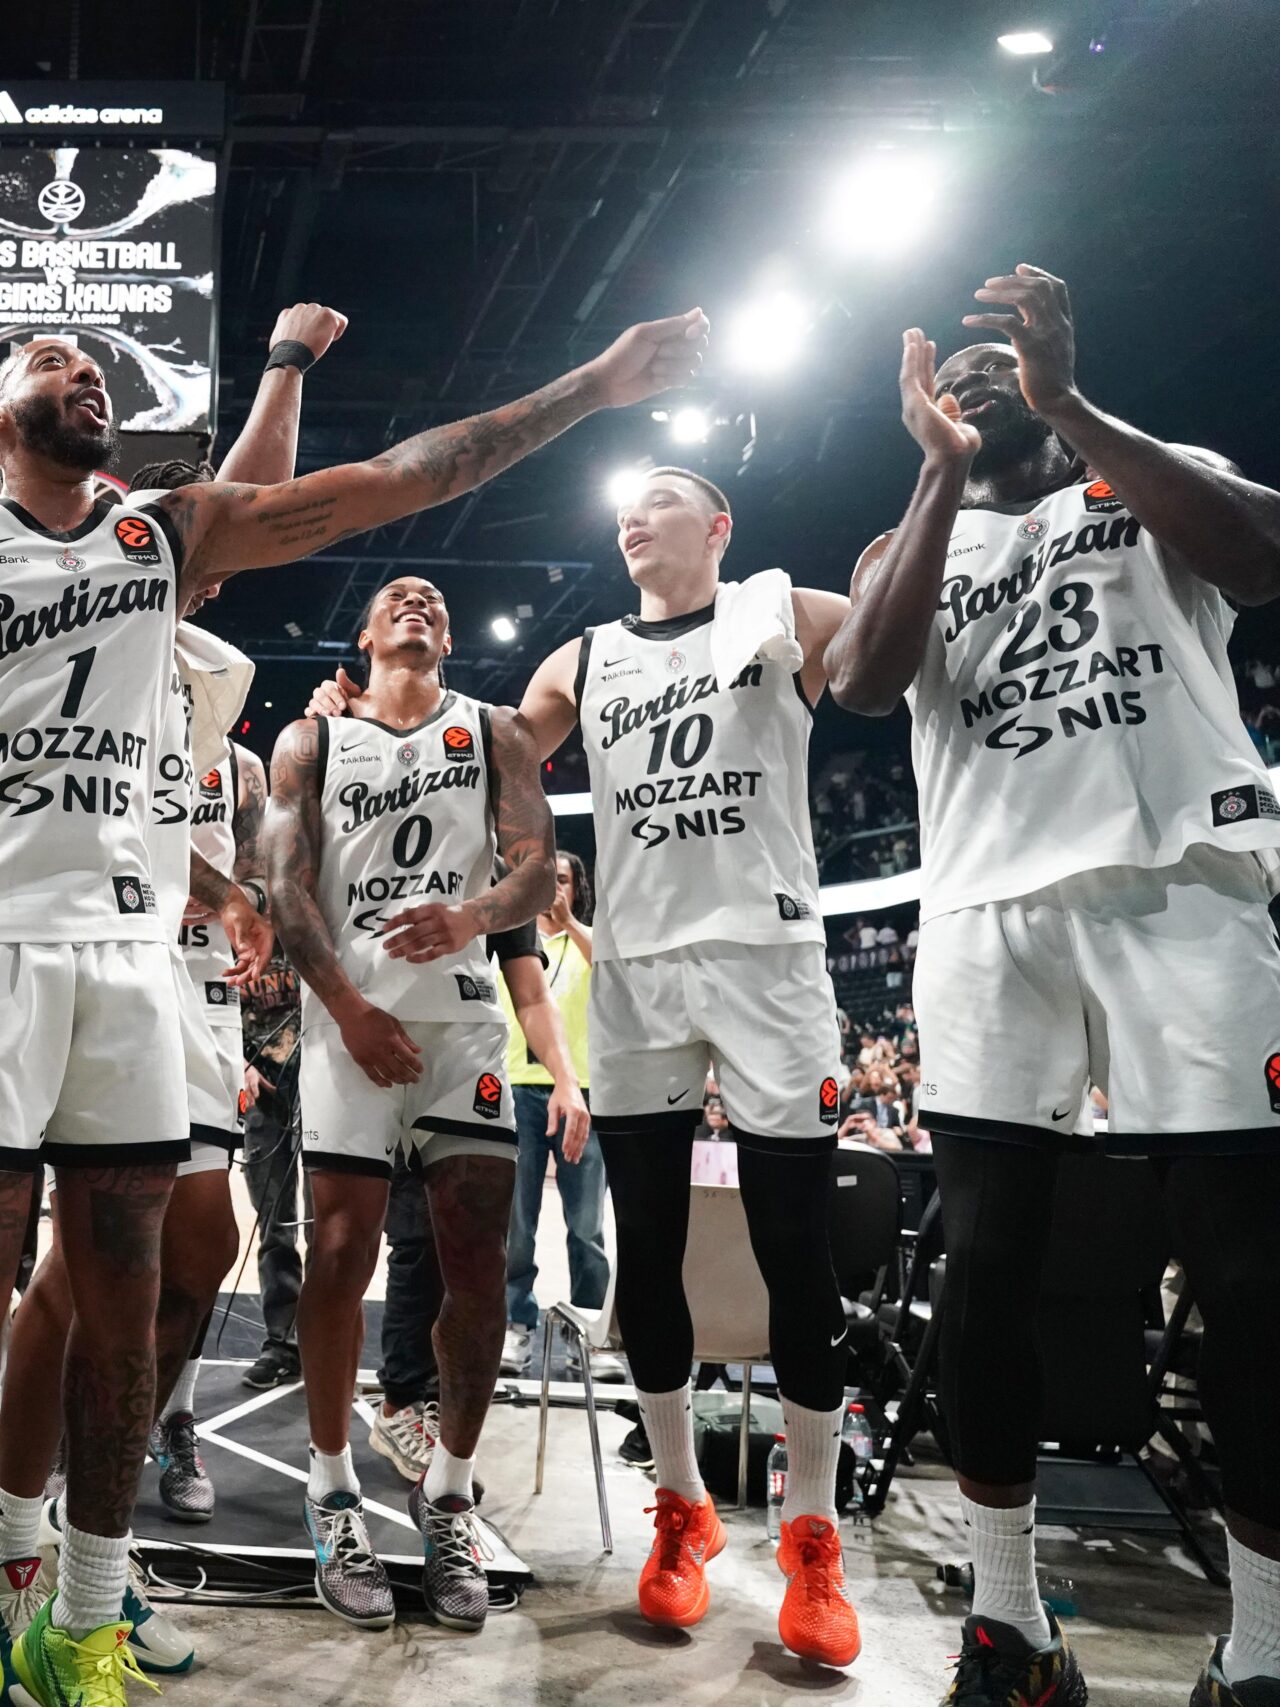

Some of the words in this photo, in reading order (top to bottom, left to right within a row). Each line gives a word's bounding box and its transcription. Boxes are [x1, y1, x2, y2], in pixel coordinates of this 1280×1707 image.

[25, 105, 98, 124] adidas
[100, 108, 163, 124] arena
[21, 240, 182, 269] BASKETBALL
[65, 283, 172, 313] KAUNAS
[1089, 500, 1123, 511] ETIHA
[126, 553, 159, 562] ETIHAD
[947, 542, 987, 559] kBank
[937, 515, 1141, 643] Partizan
[1000, 581, 1099, 674] 23
[59, 645, 98, 719] 1
[959, 644, 1166, 729] MOZZART
[1057, 691, 1147, 738] NIS
[646, 713, 714, 775] 10
[62, 774, 131, 817] NIS
[338, 761, 481, 834] Partizan
[615, 771, 762, 815] MOZZART
[392, 813, 433, 869] 0
[675, 807, 746, 840] NIS
[348, 871, 464, 907] MOZZART
